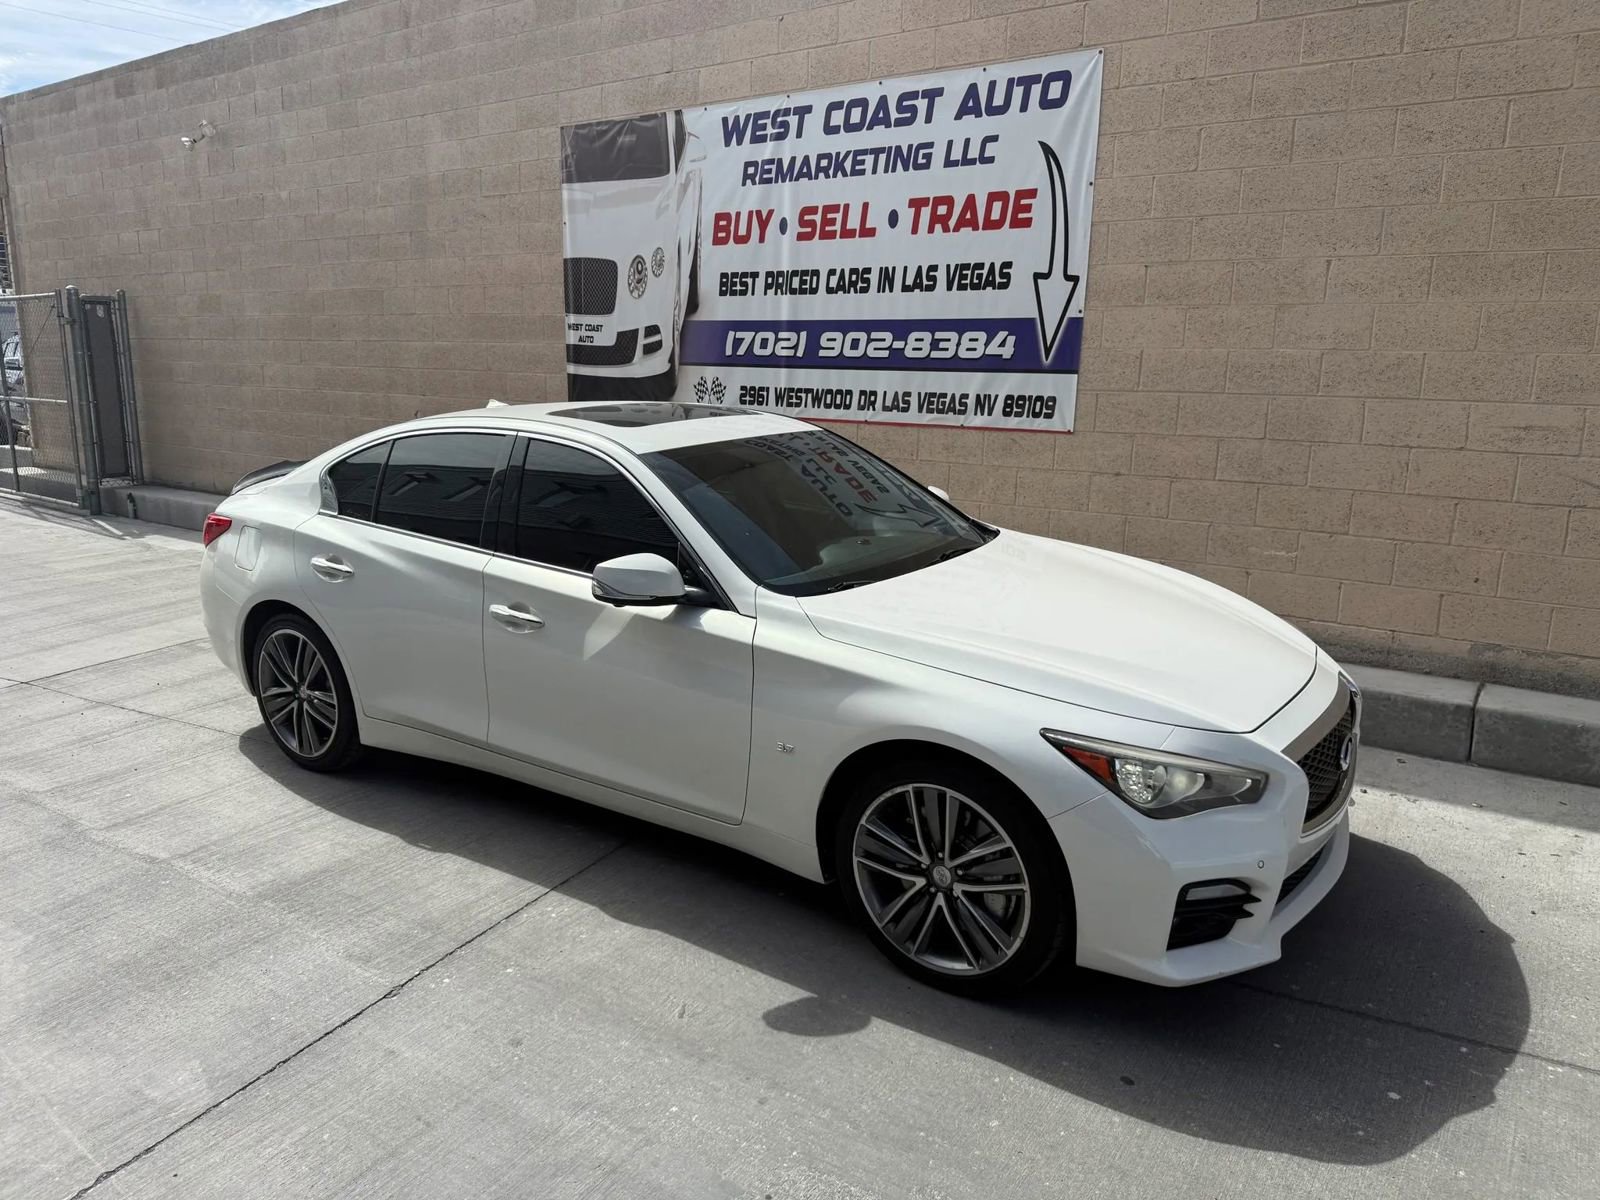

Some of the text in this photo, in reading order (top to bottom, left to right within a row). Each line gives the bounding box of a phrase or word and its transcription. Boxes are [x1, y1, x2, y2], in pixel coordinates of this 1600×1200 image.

[721, 69, 1073, 148] WEST COAST AUTO
[741, 134, 1000, 187] REMARKETING LLC
[712, 188, 1038, 246] BUY SELL TRADE
[718, 260, 1013, 297] BEST PRICED CARS IN LAS VEGAS
[567, 323, 604, 333] WEST COAST
[578, 335, 595, 344] AUTO
[725, 330, 1016, 359] (702) 902-8384
[739, 385, 1058, 420] 2961 WESTWOOD DR LAS VEGAS NV 89109
